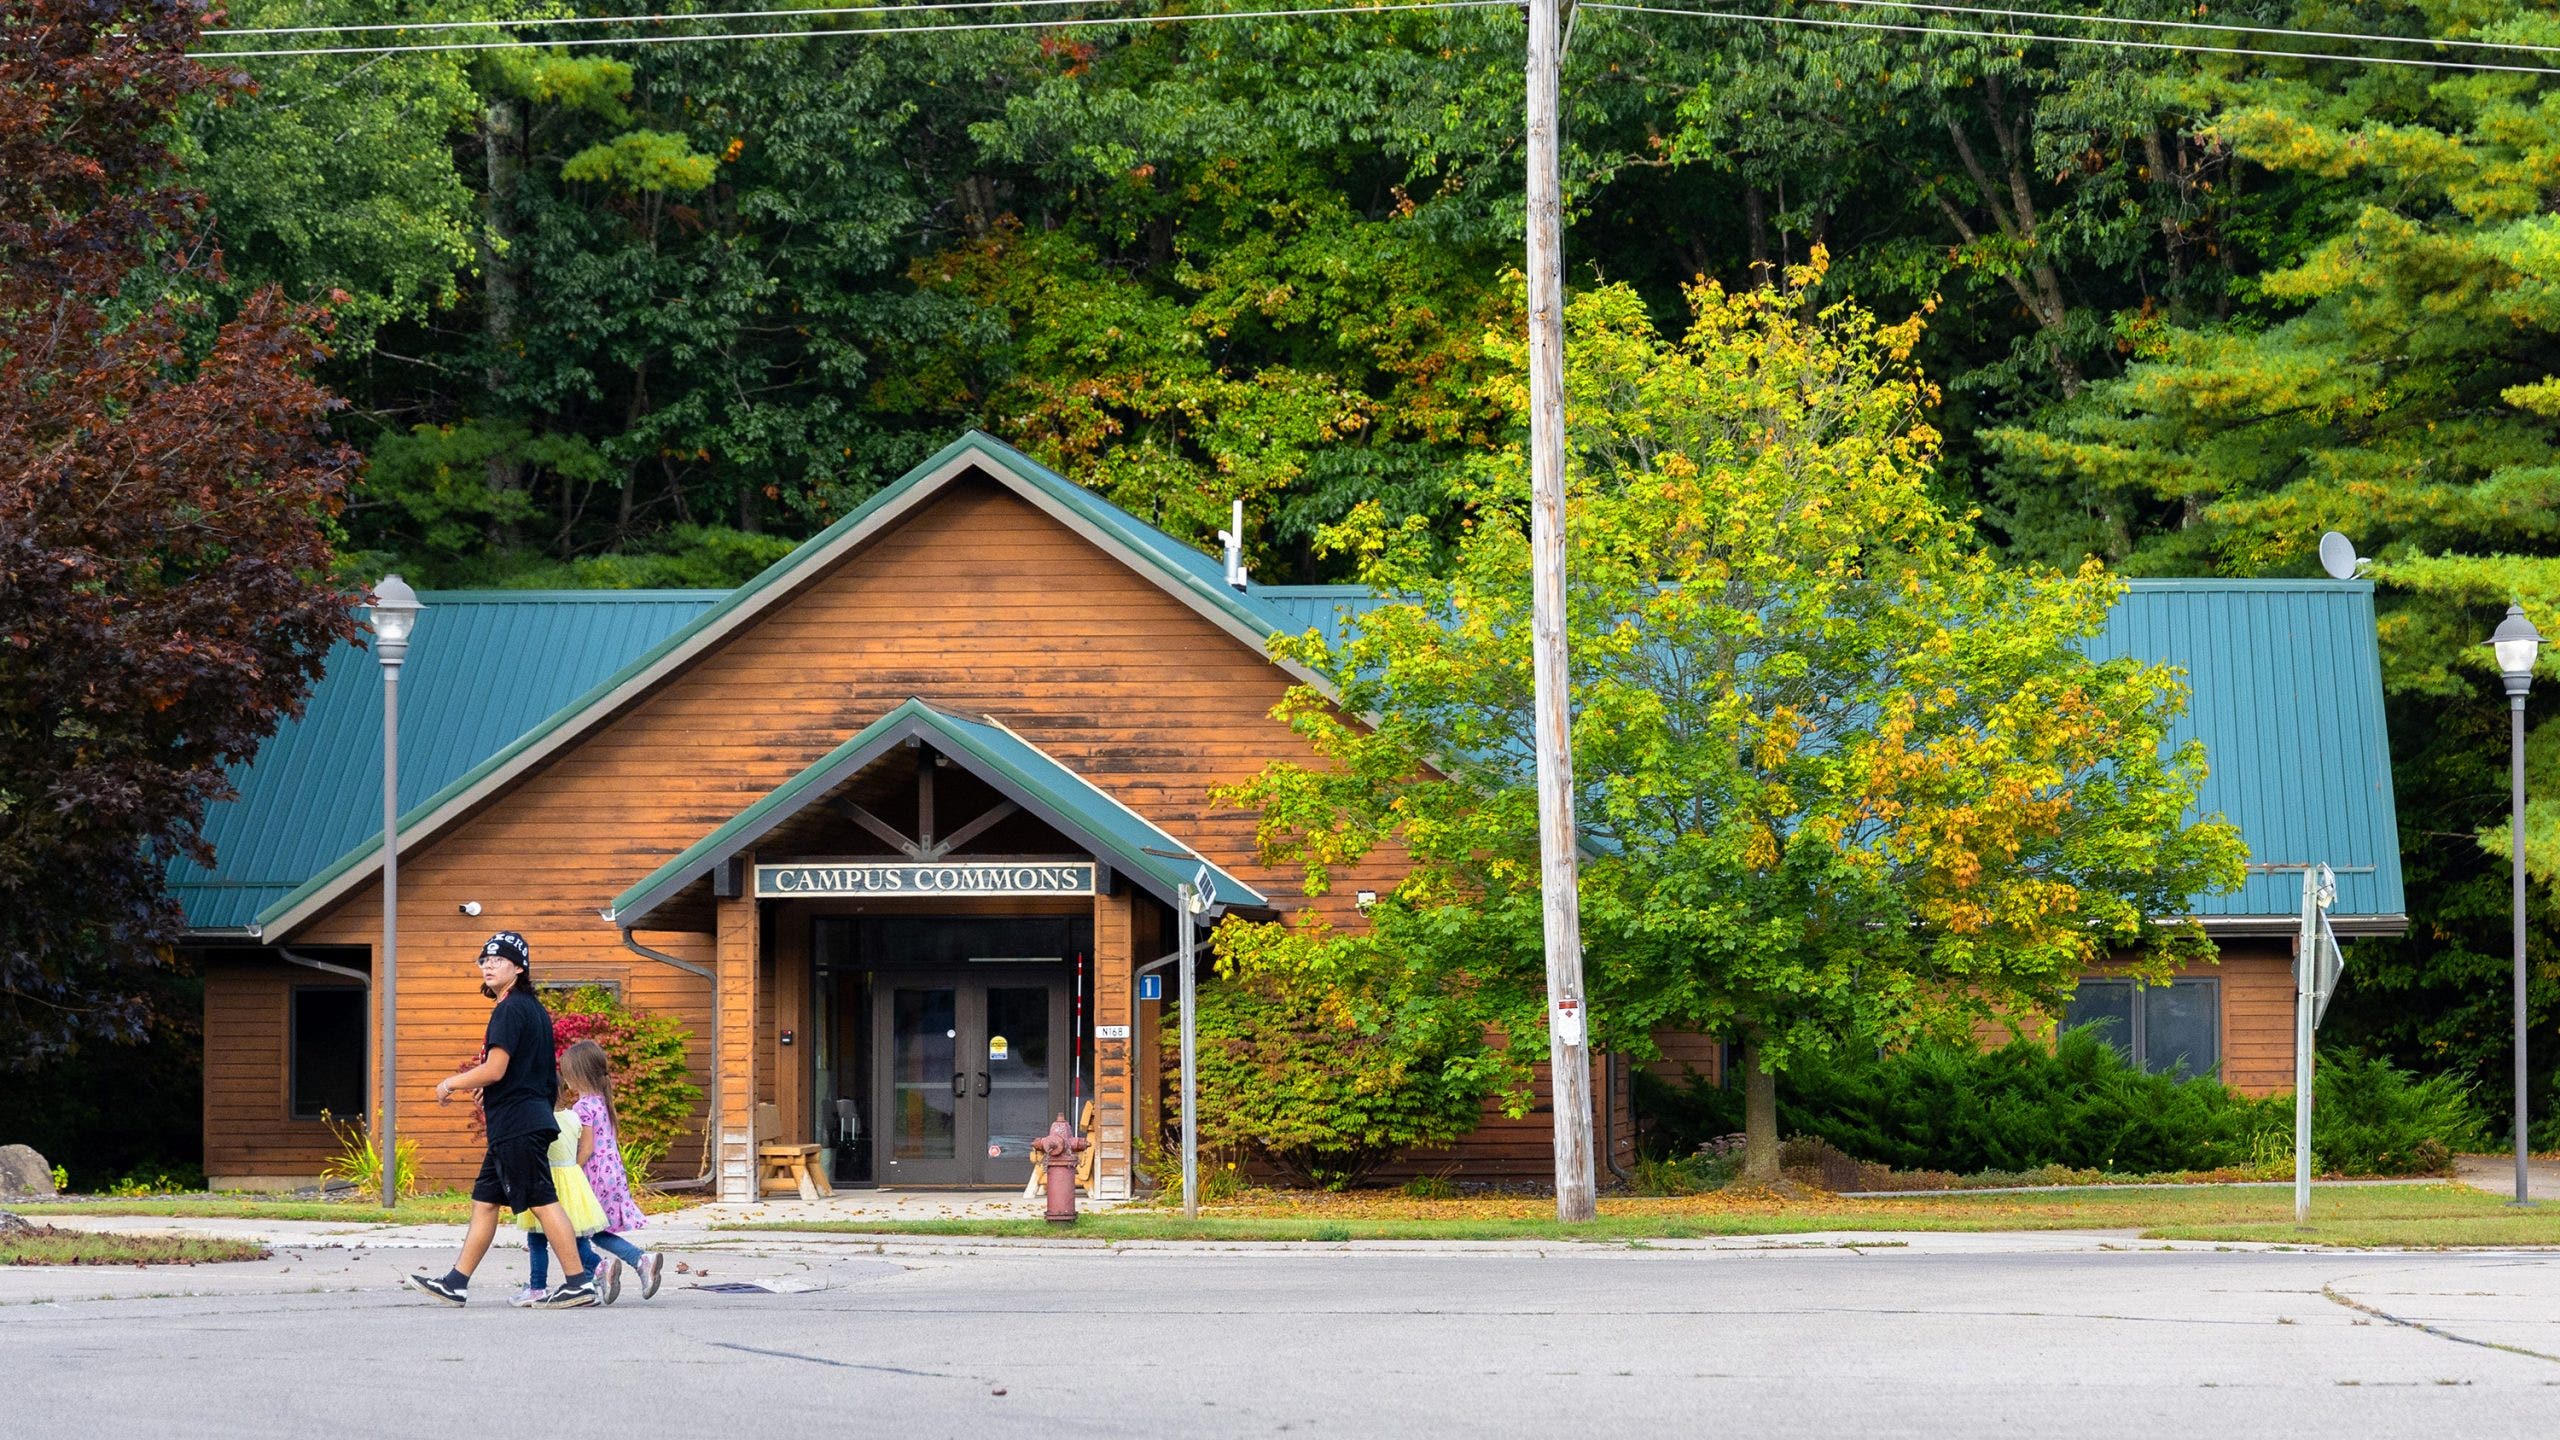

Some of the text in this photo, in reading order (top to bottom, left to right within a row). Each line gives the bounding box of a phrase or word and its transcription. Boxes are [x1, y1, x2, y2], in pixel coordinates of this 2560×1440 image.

[775, 868, 1079, 892] CAMPUS COMMONS
[1102, 1027, 1123, 1037] N168
